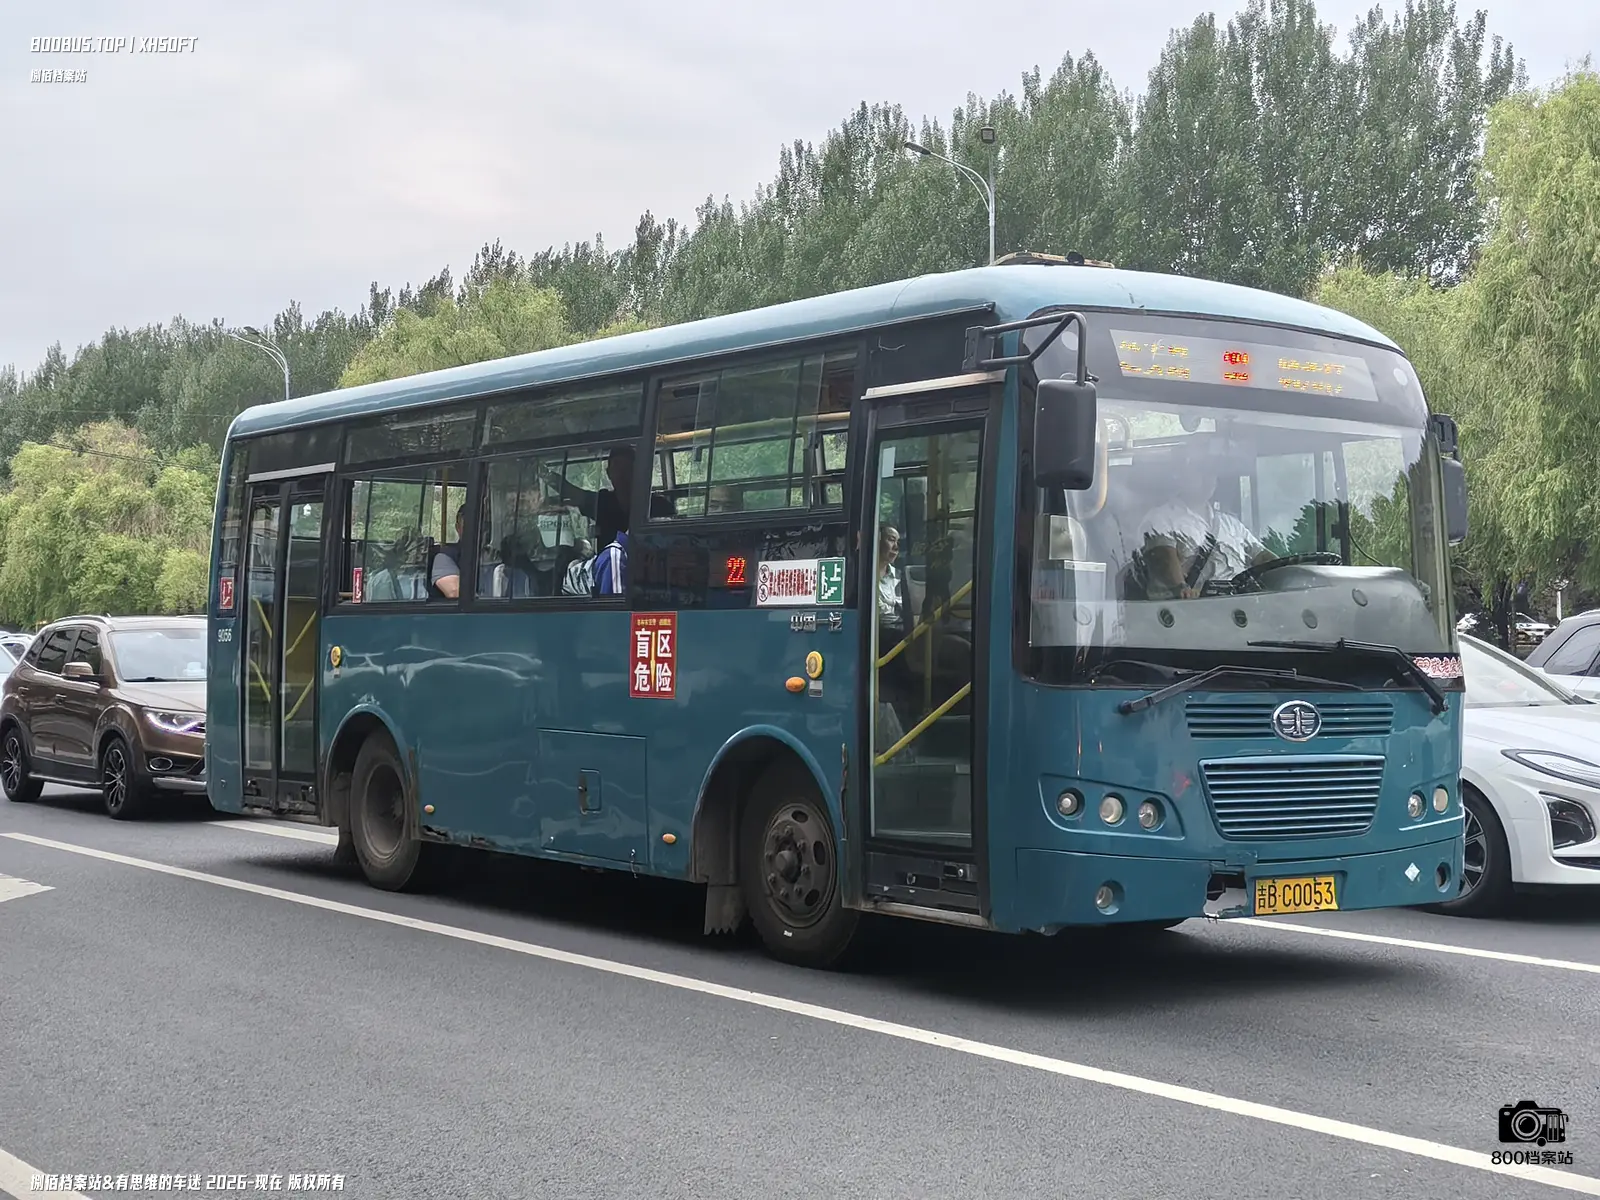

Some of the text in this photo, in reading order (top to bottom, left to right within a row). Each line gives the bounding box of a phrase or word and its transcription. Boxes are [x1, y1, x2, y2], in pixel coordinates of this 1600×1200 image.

[727, 557, 745, 583] 22
[830, 563, 841, 581] 上
[635, 628, 672, 658] 盲区
[634, 661, 672, 692] 危险
